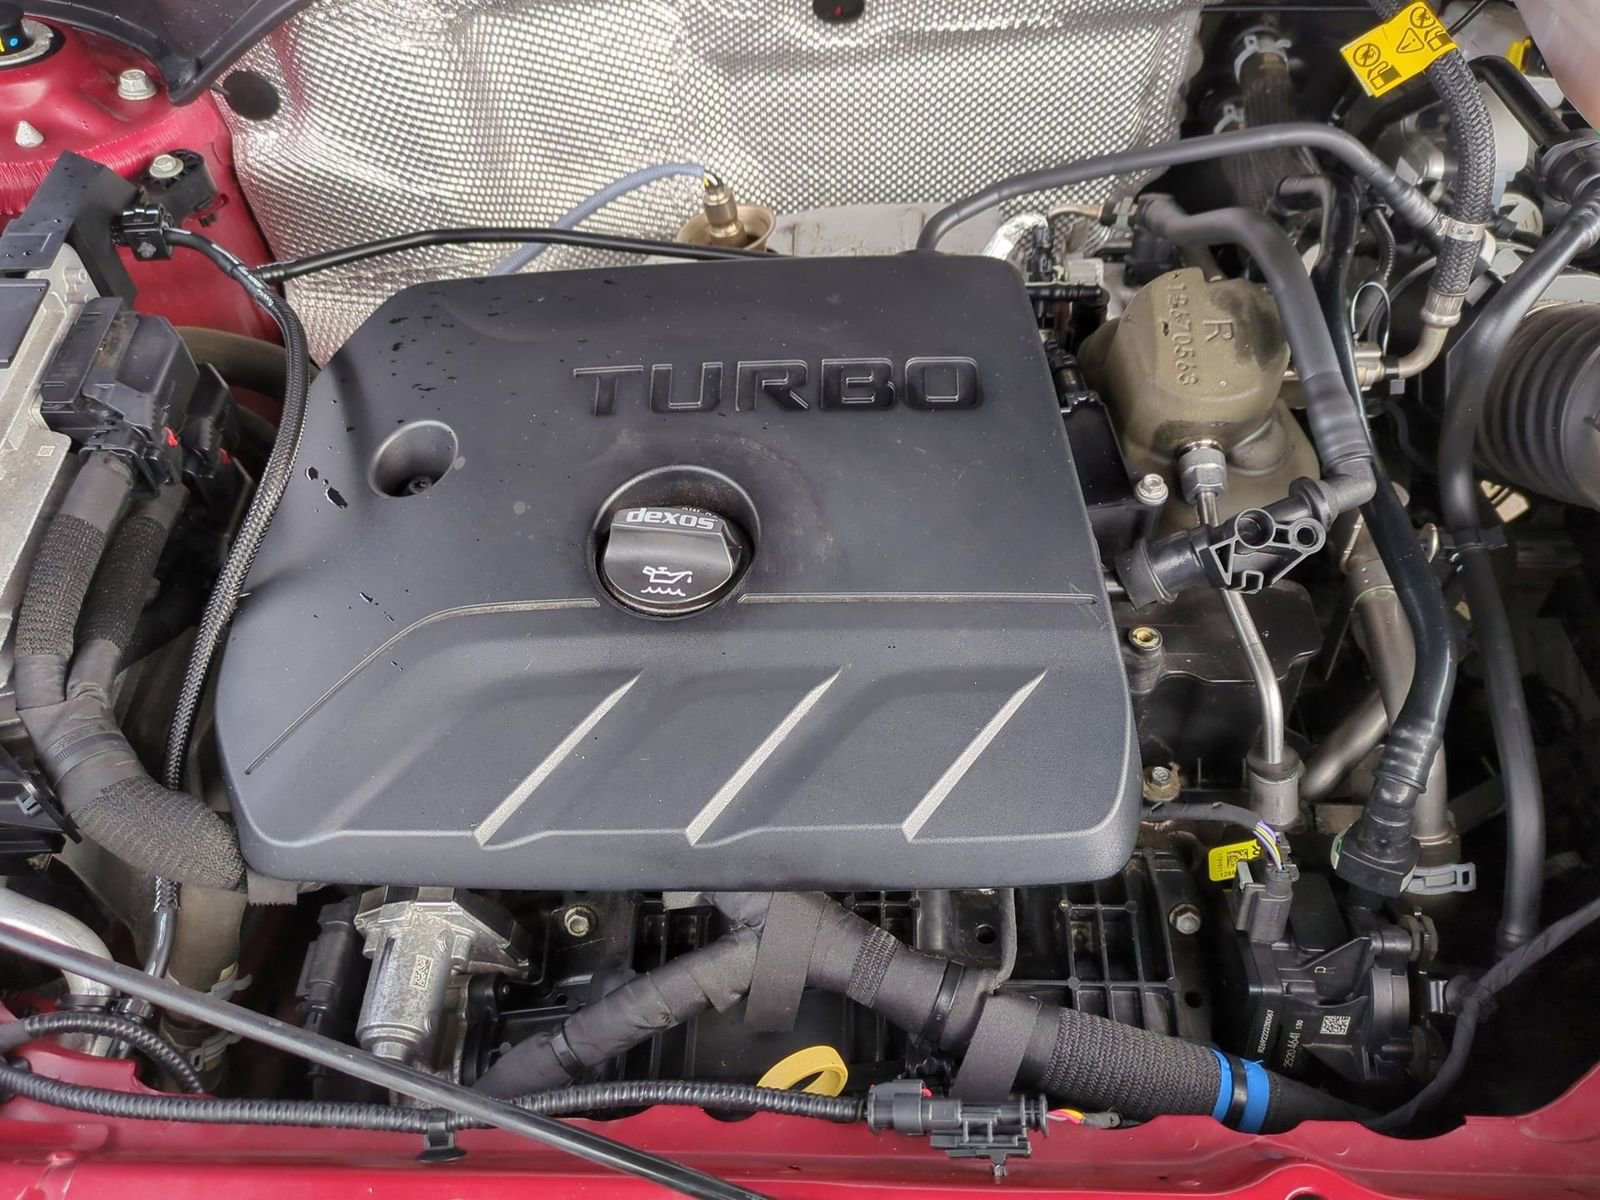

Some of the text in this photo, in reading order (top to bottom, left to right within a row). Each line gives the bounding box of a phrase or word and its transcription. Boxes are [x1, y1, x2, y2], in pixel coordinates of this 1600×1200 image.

[1202, 319, 1235, 342] R
[572, 355, 984, 416] TURBO
[625, 507, 714, 530] dexos
